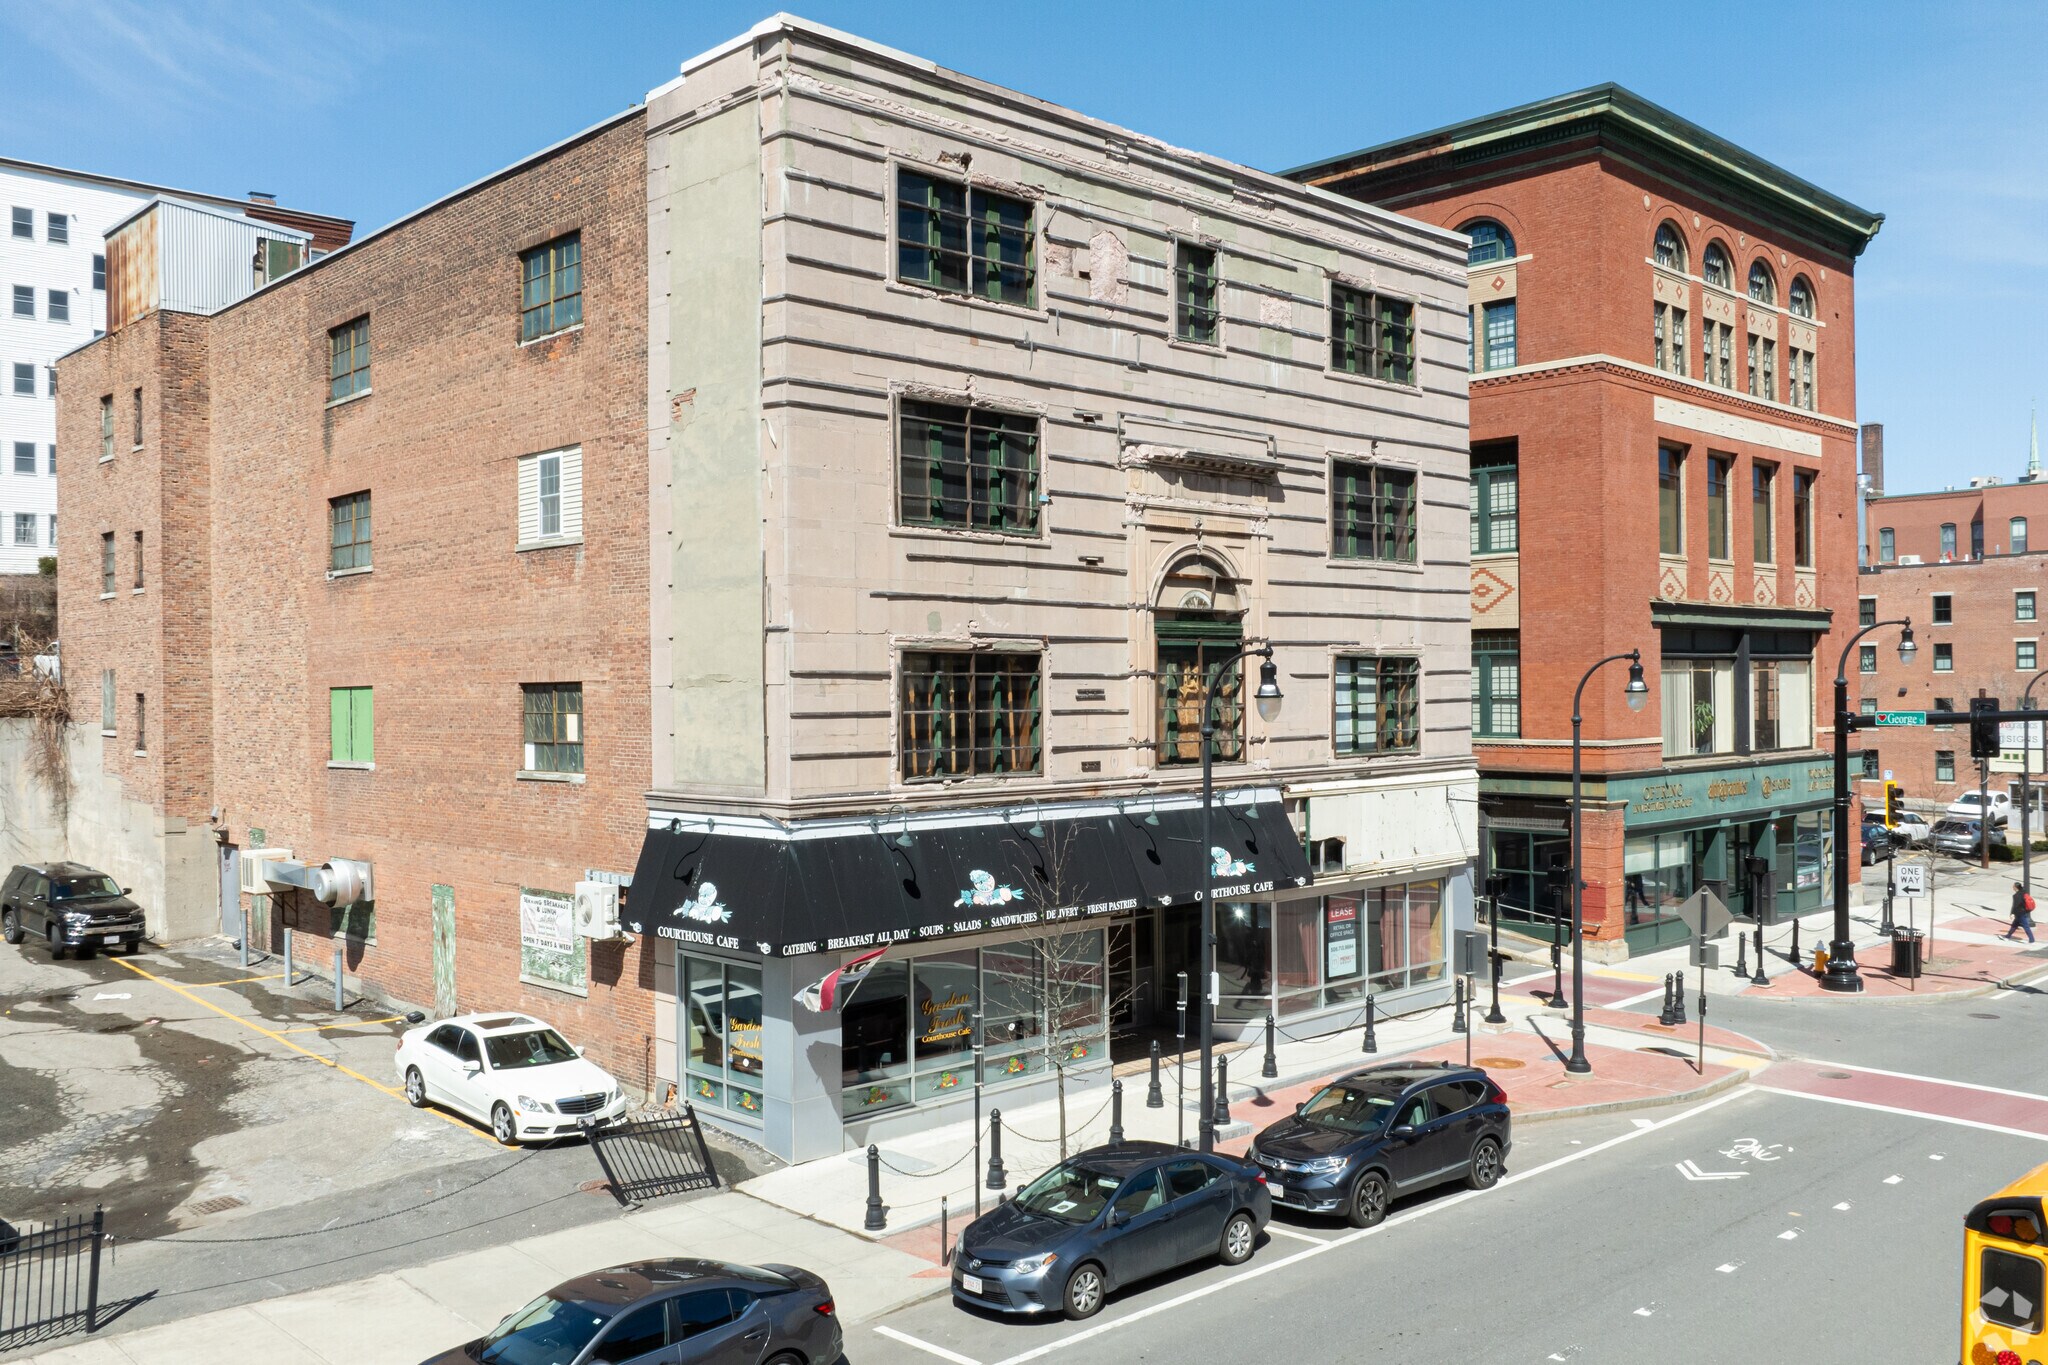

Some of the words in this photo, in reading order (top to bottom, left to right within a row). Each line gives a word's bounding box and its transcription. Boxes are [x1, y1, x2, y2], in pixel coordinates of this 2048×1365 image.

[1887, 713, 1917, 725] George
[1900, 867, 1920, 875] ONE
[1900, 876, 1920, 884] WAY
[1253, 881, 1274, 894] CAFE
[543, 899, 569, 910] BREAKFAST
[1331, 907, 1353, 918] LEASE
[782, 941, 817, 956] CATERING
[827, 933, 875, 950] BREAKFAST
[876, 930, 893, 942] ALL
[893, 929, 911, 940] DAY
[919, 924, 944, 938] SOUPS
[953, 919, 982, 933] SALADS
[990, 912, 1038, 928] SANDWICHES
[1087, 902, 1108, 915] FRESH
[1108, 898, 1138, 911] PASTRIES
[523, 935, 535, 944] OPEN
[540, 940, 553, 948] DAYS
[559, 943, 572, 951] WEEK
[657, 926, 714, 945] COURTHOUSE
[716, 935, 739, 950] CAFE
[921, 992, 970, 1016] Garden
[928, 1009, 965, 1034] Fresh
[922, 1033, 957, 1043] Courthouse
[957, 1026, 972, 1036] Cafe
